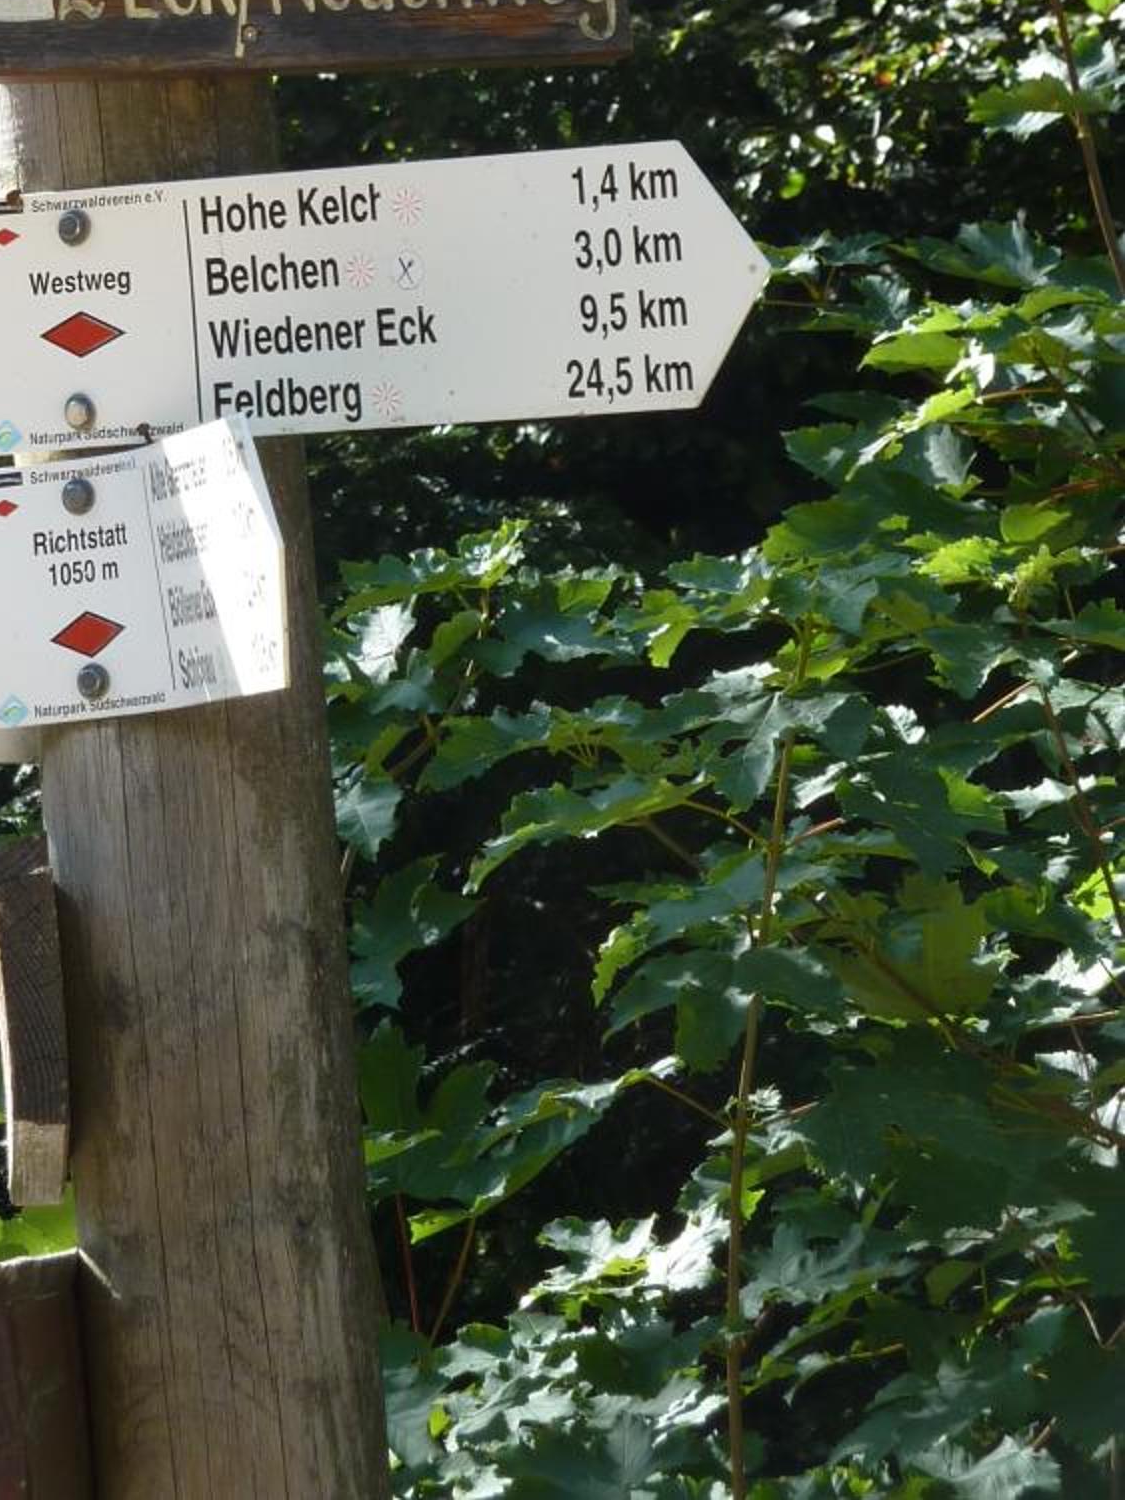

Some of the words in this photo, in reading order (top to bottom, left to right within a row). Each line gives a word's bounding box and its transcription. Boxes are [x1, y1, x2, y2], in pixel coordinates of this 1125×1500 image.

[200, 192, 287, 235] Hohe
[571, 164, 618, 211] 1,4
[630, 162, 678, 200] km
[29, 270, 131, 295] Westweg
[206, 252, 339, 296] Belchen
[575, 228, 622, 274] 3,0
[633, 225, 682, 264] km
[209, 314, 365, 359] Wiedener
[376, 306, 436, 348] Eck
[580, 293, 627, 338] 9,5
[639, 290, 687, 328] km
[213, 378, 362, 422] Feldberg
[566, 358, 633, 403] 24,5
[644, 354, 693, 393] km
[33, 523, 128, 555] Richtstatt
[49, 560, 96, 586] 1050
[102, 562, 120, 579] m
